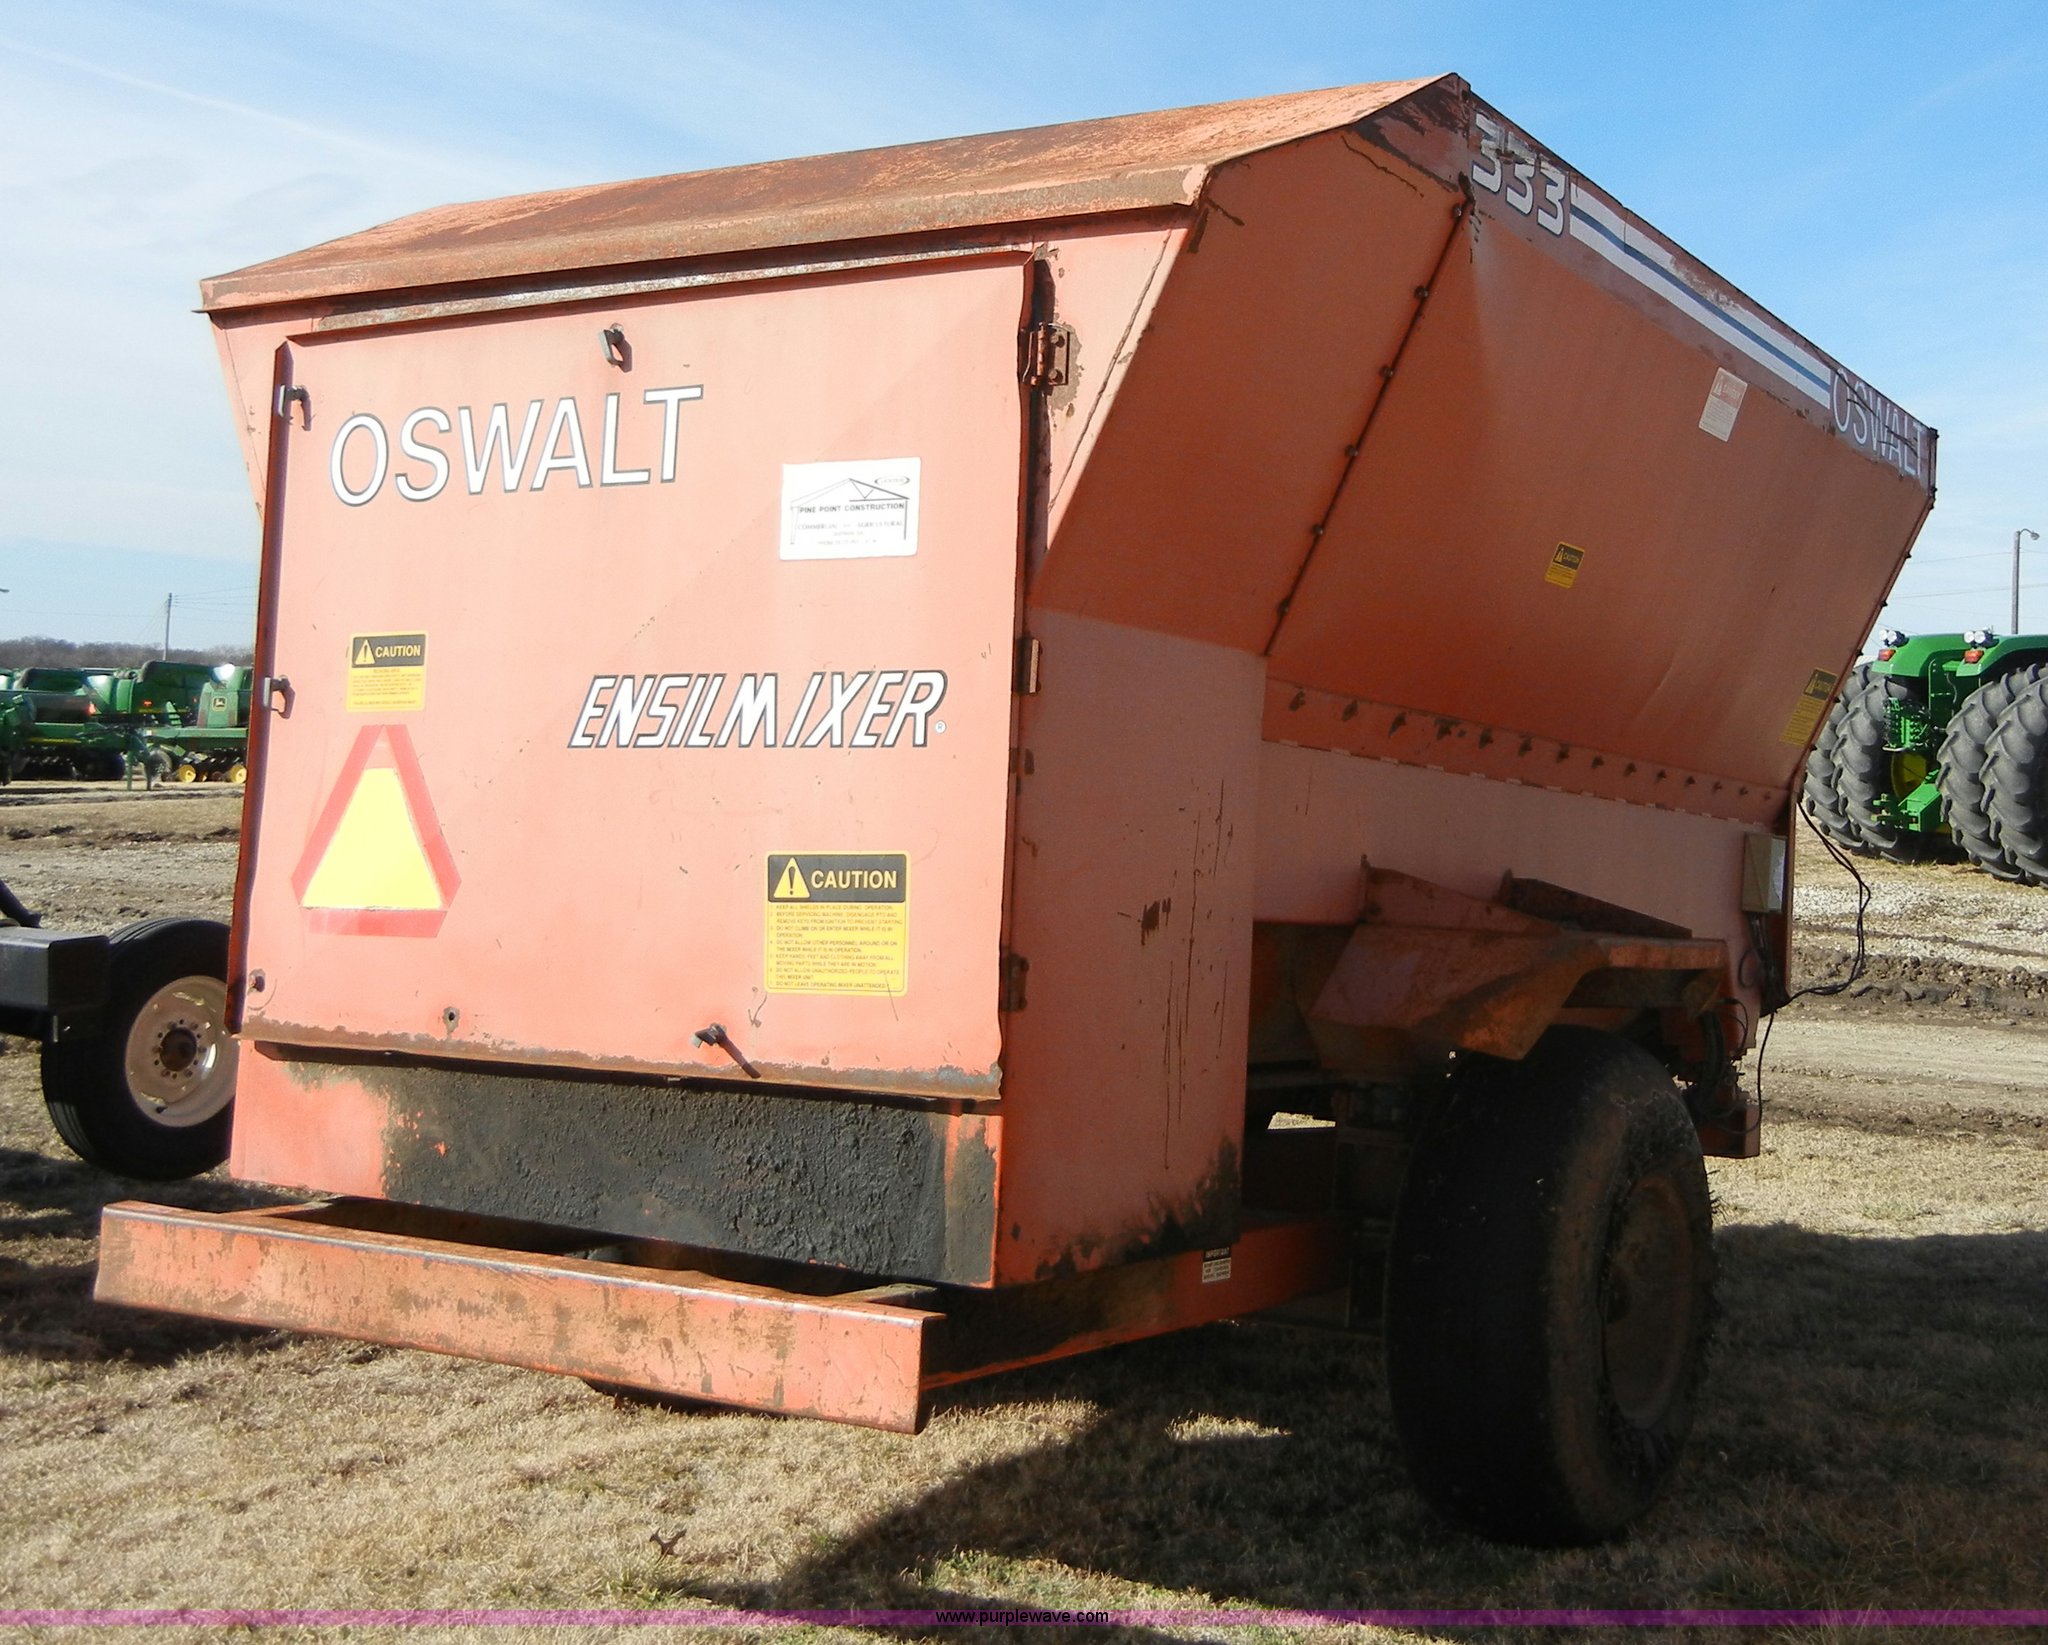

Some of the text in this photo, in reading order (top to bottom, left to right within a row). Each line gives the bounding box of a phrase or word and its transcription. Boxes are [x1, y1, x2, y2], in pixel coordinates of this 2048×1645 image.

[1471, 109, 1567, 236] 333
[329, 383, 704, 507] OSWALT
[1833, 368, 1926, 477] OSWALT
[800, 502, 905, 514] PINE POINT CONSTRUCTION
[375, 644, 421, 658] CAUTION
[811, 869, 897, 889] CAUTION
